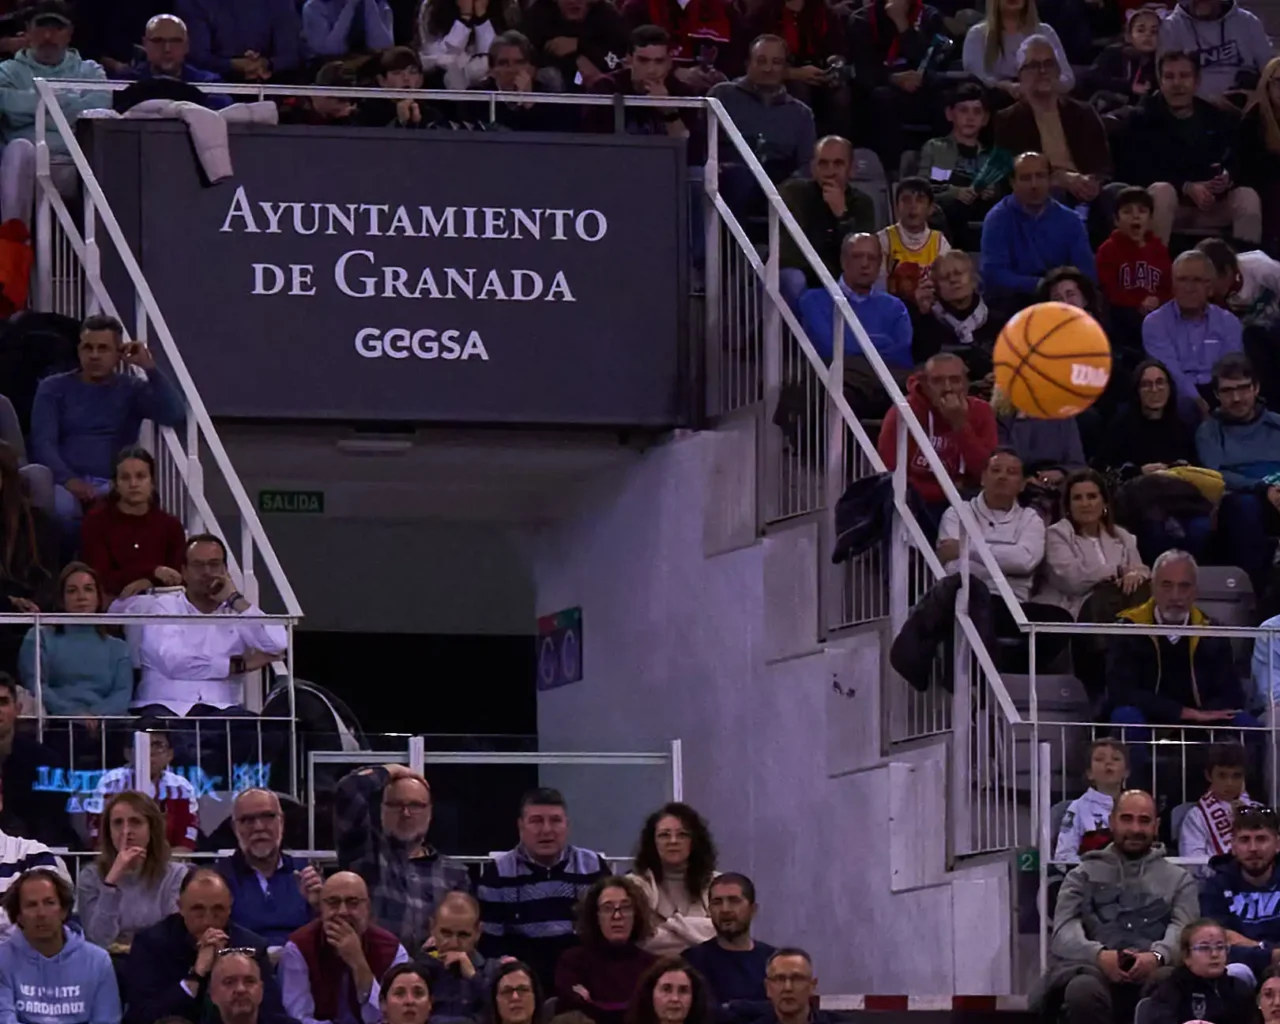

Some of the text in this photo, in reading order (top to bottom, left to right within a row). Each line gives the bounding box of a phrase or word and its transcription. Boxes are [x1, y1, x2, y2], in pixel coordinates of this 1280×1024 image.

[220, 185, 608, 242] AYUNTAMIENTO
[251, 249, 577, 302] DE GRANADA
[263, 494, 320, 510] SALIDA
[1022, 855, 1034, 873] 2
